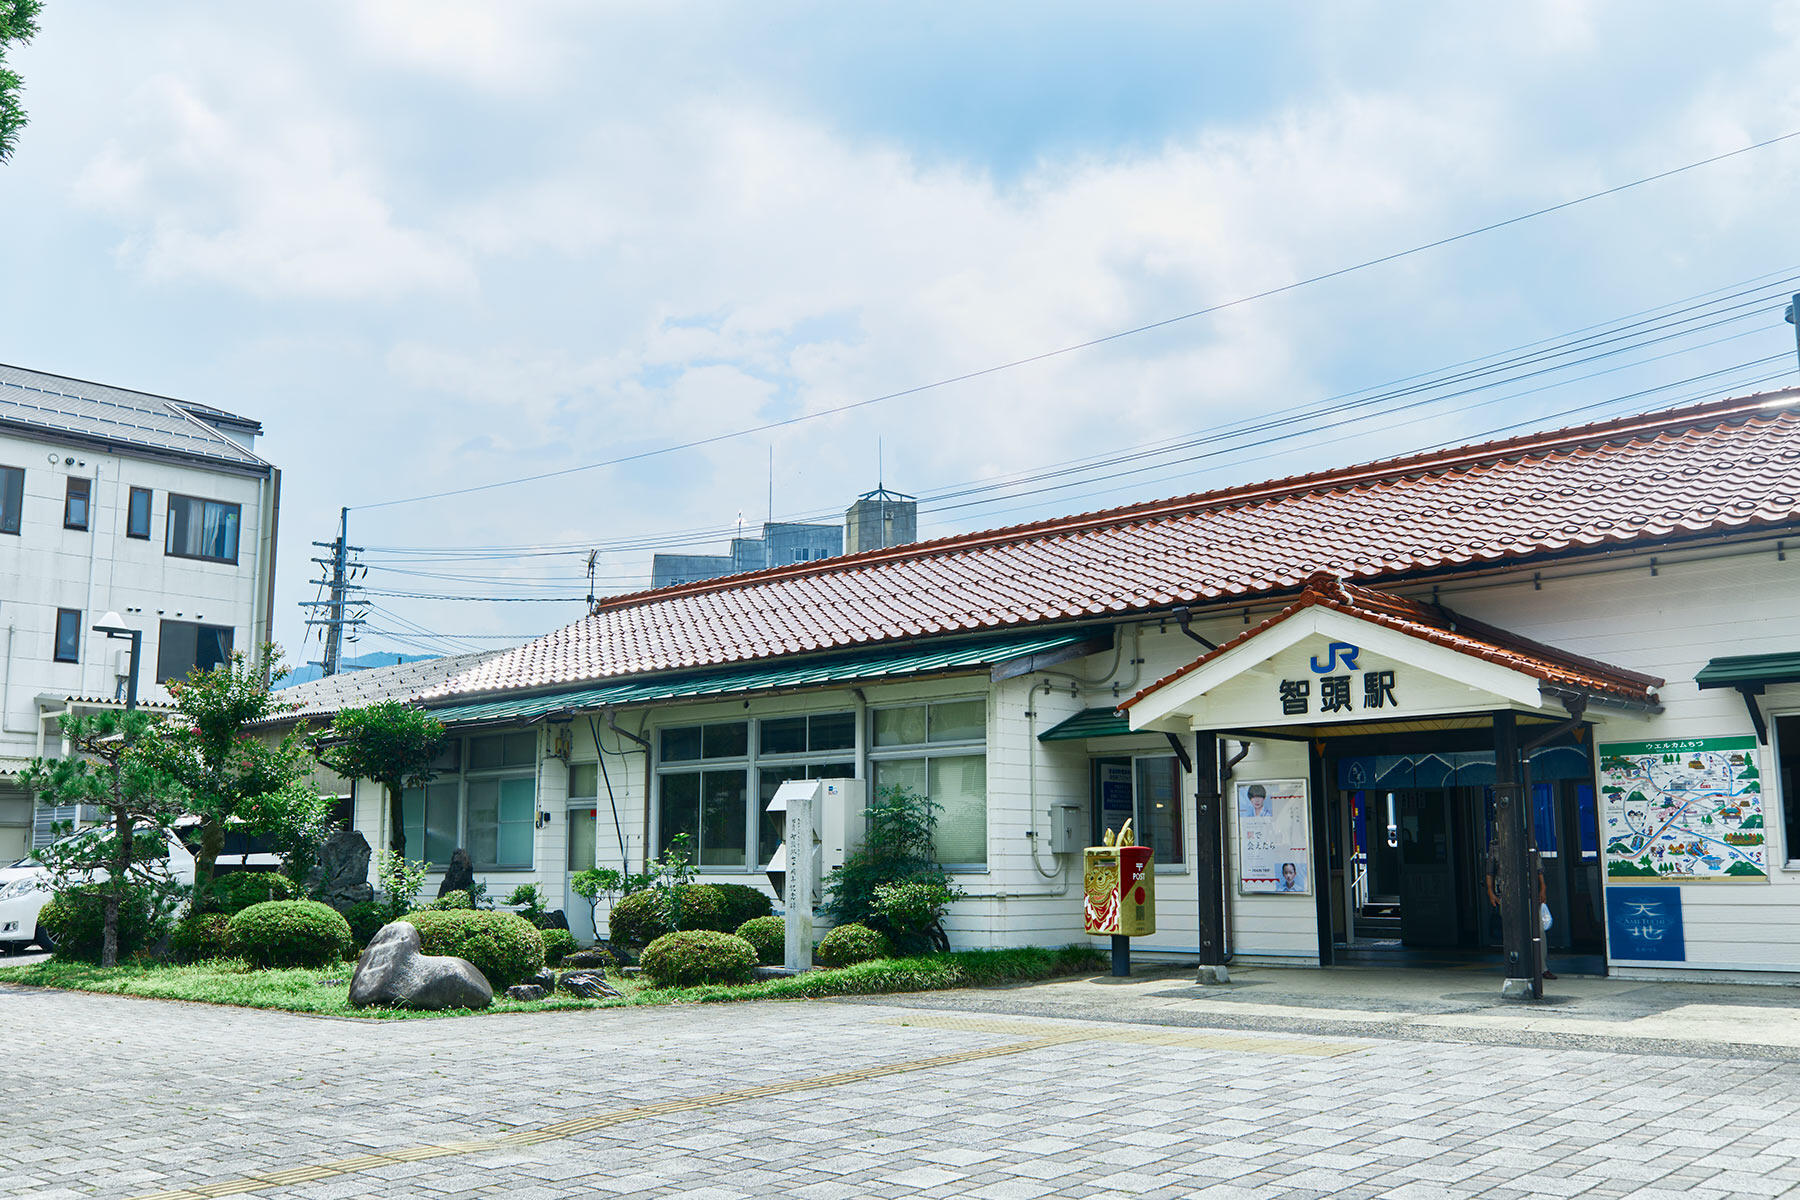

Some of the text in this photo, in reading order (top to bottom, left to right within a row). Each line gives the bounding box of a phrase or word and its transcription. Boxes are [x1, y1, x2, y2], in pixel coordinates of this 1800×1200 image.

[1310, 642, 1361, 674] JR
[1279, 670, 1398, 716] 智頭駅
[1132, 872, 1146, 881] POST
